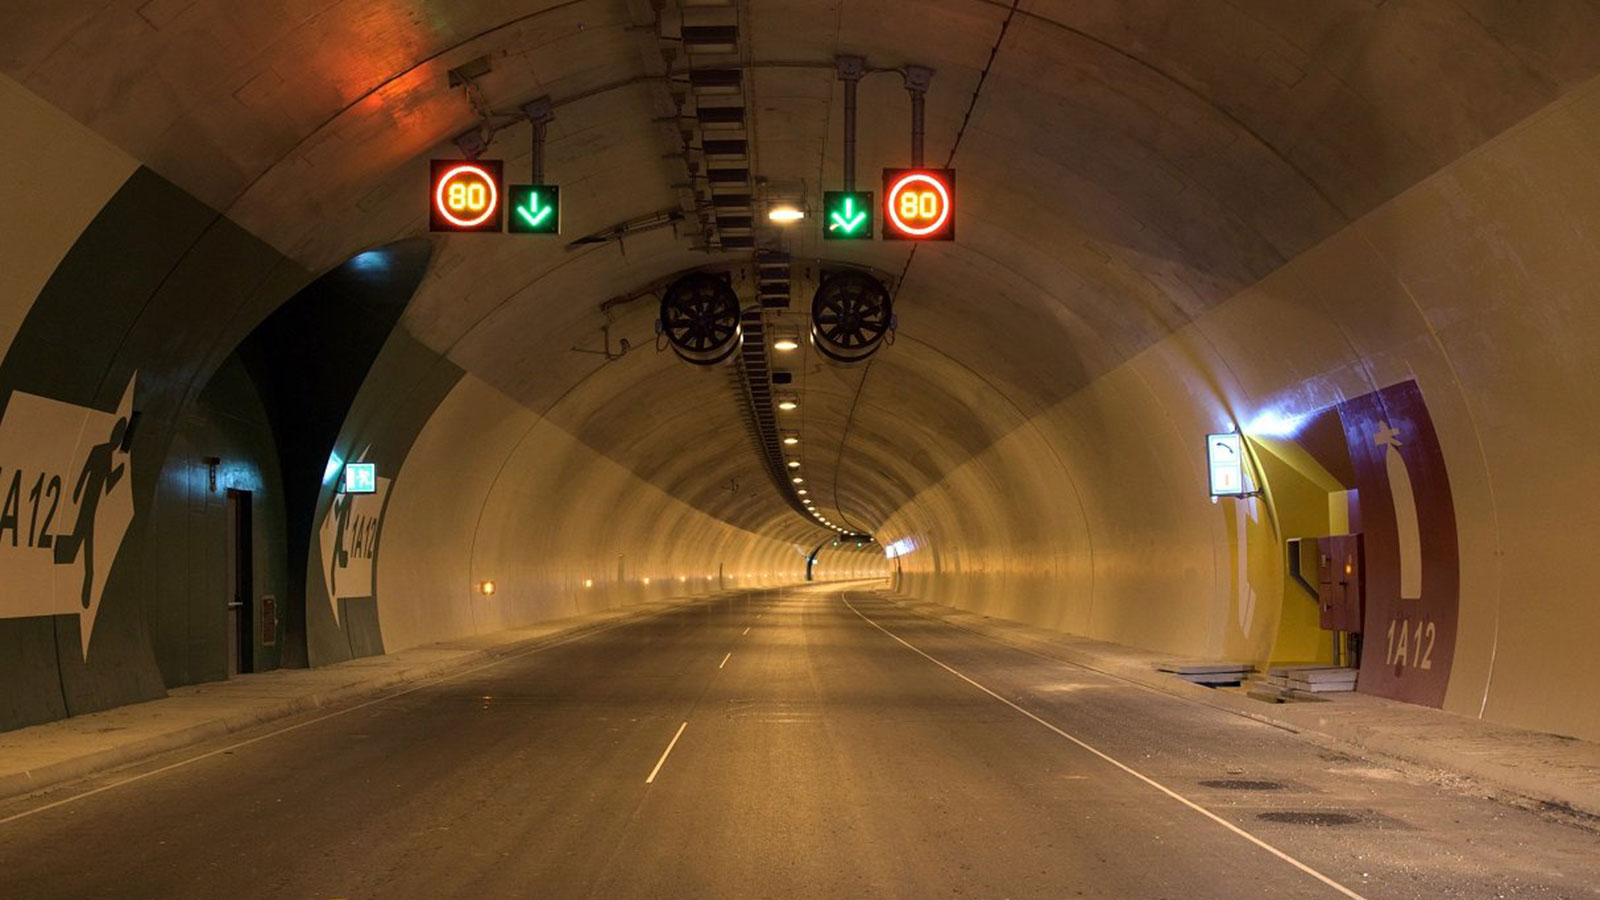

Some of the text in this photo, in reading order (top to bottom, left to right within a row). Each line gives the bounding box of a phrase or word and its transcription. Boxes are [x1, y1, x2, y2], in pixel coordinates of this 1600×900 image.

[448, 182, 486, 210] 80
[900, 191, 937, 219] 80
[0, 466, 61, 548] A12
[351, 514, 377, 559] 1A12
[1386, 619, 1436, 670] 1A12
